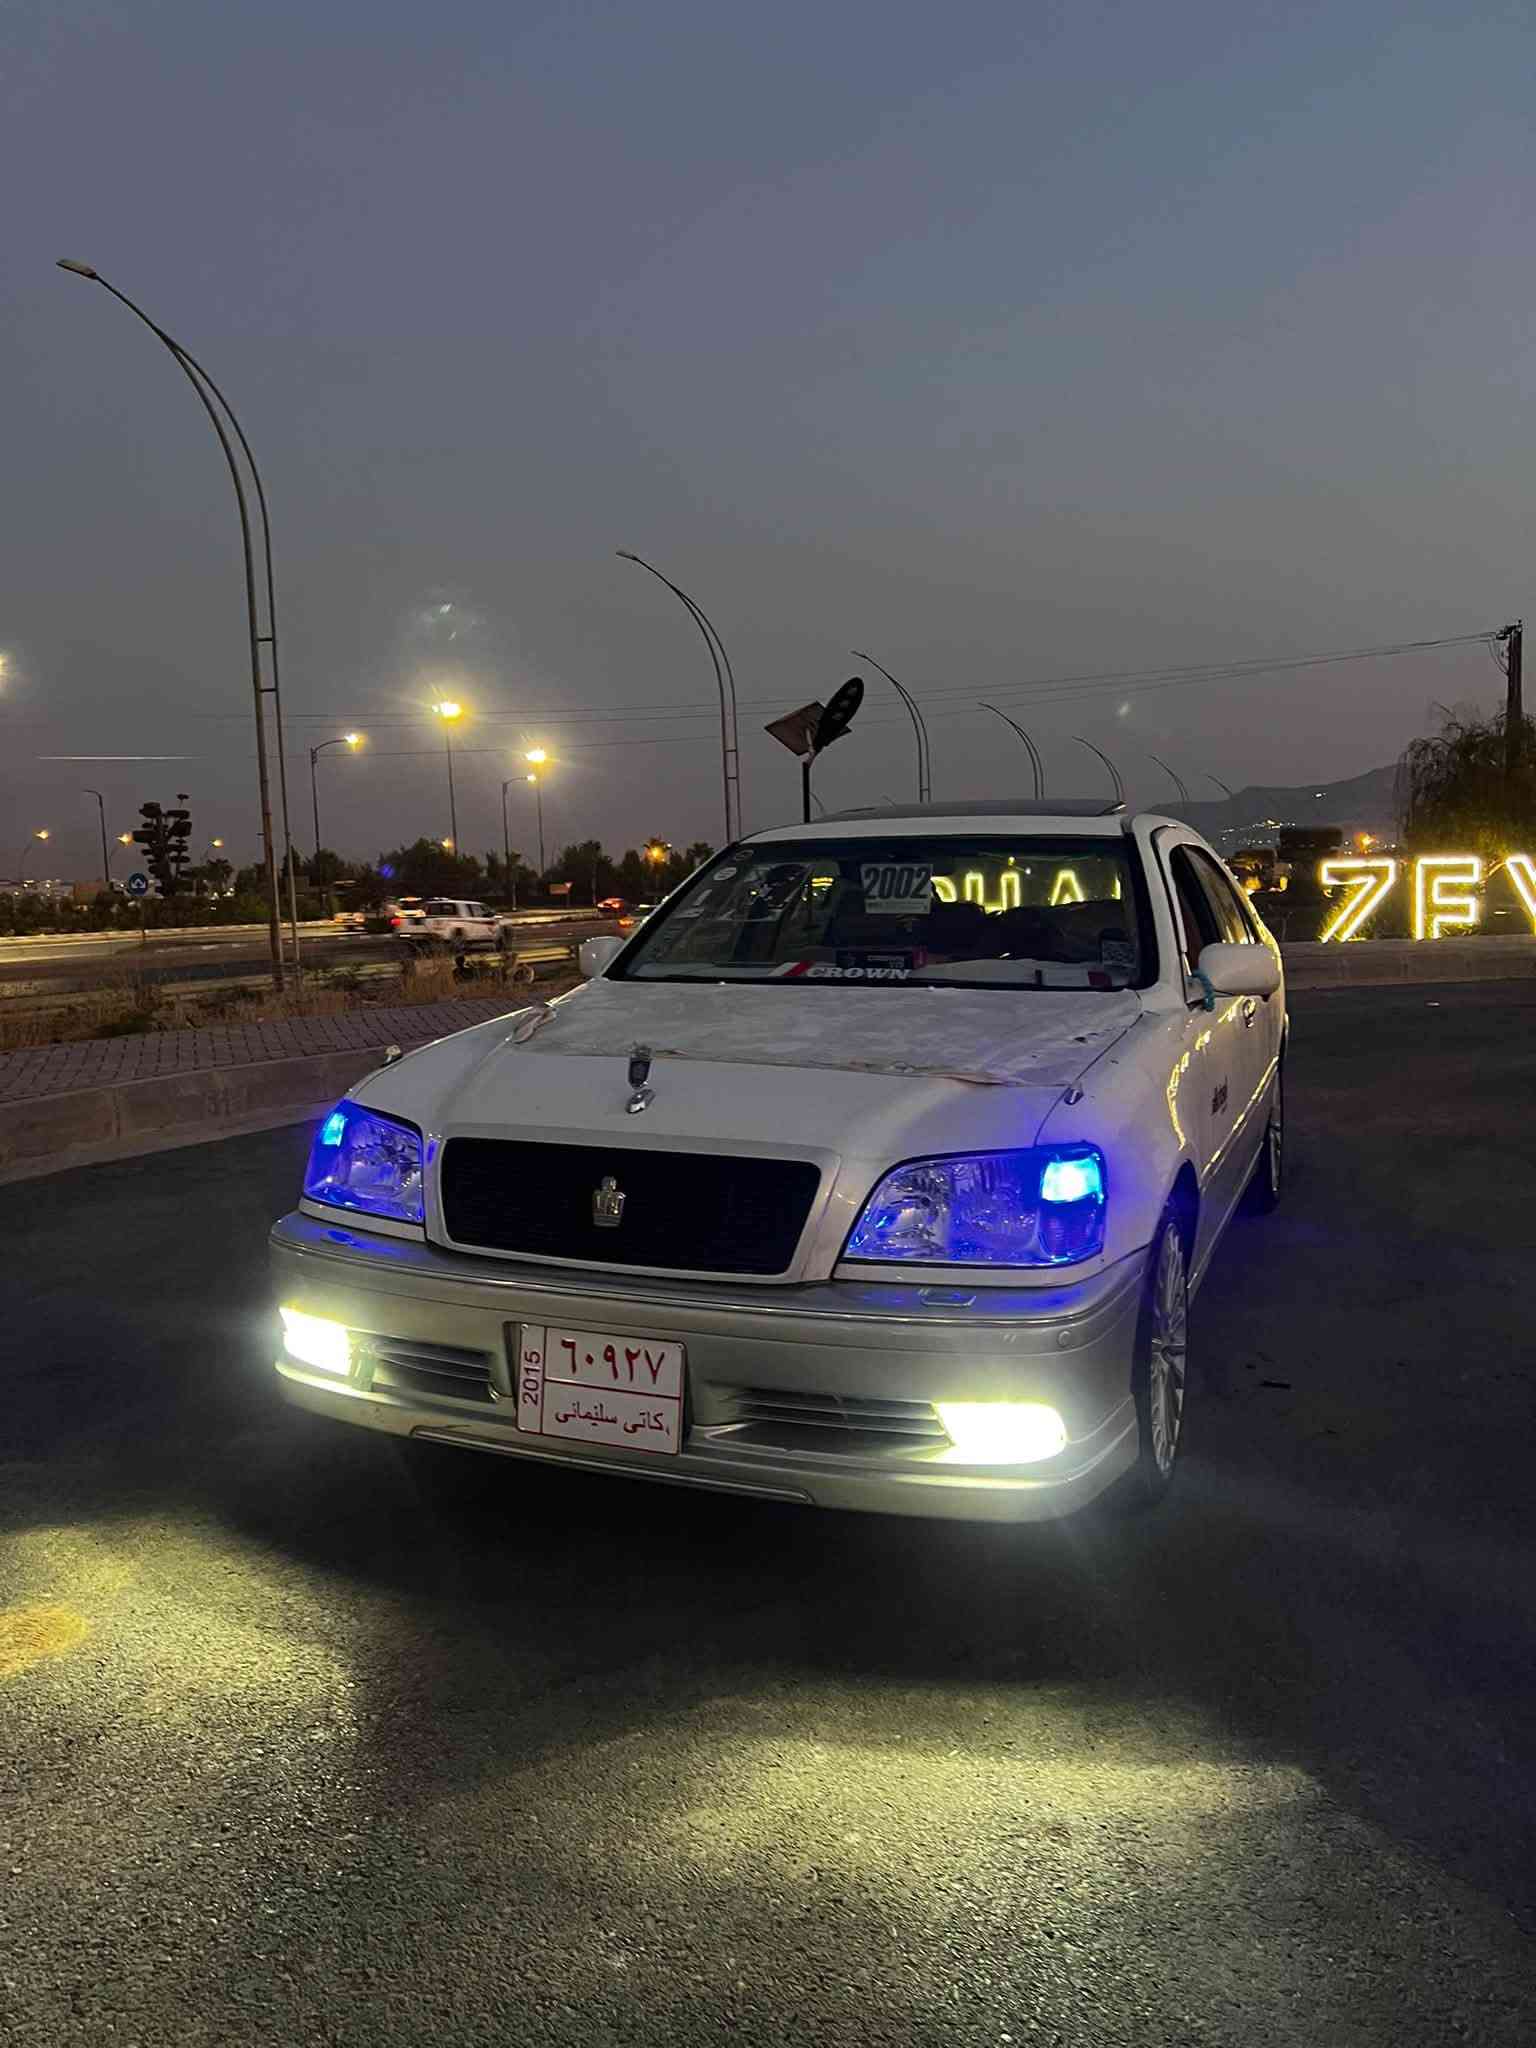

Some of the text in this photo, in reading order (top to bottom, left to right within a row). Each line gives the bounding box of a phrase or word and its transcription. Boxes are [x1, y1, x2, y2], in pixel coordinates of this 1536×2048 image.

[864, 867, 929, 899] 2002
[807, 967, 912, 980] CROWN
[522, 1350, 541, 1406] 2015
[560, 1337, 665, 1384] ٦٠٩٢٧
